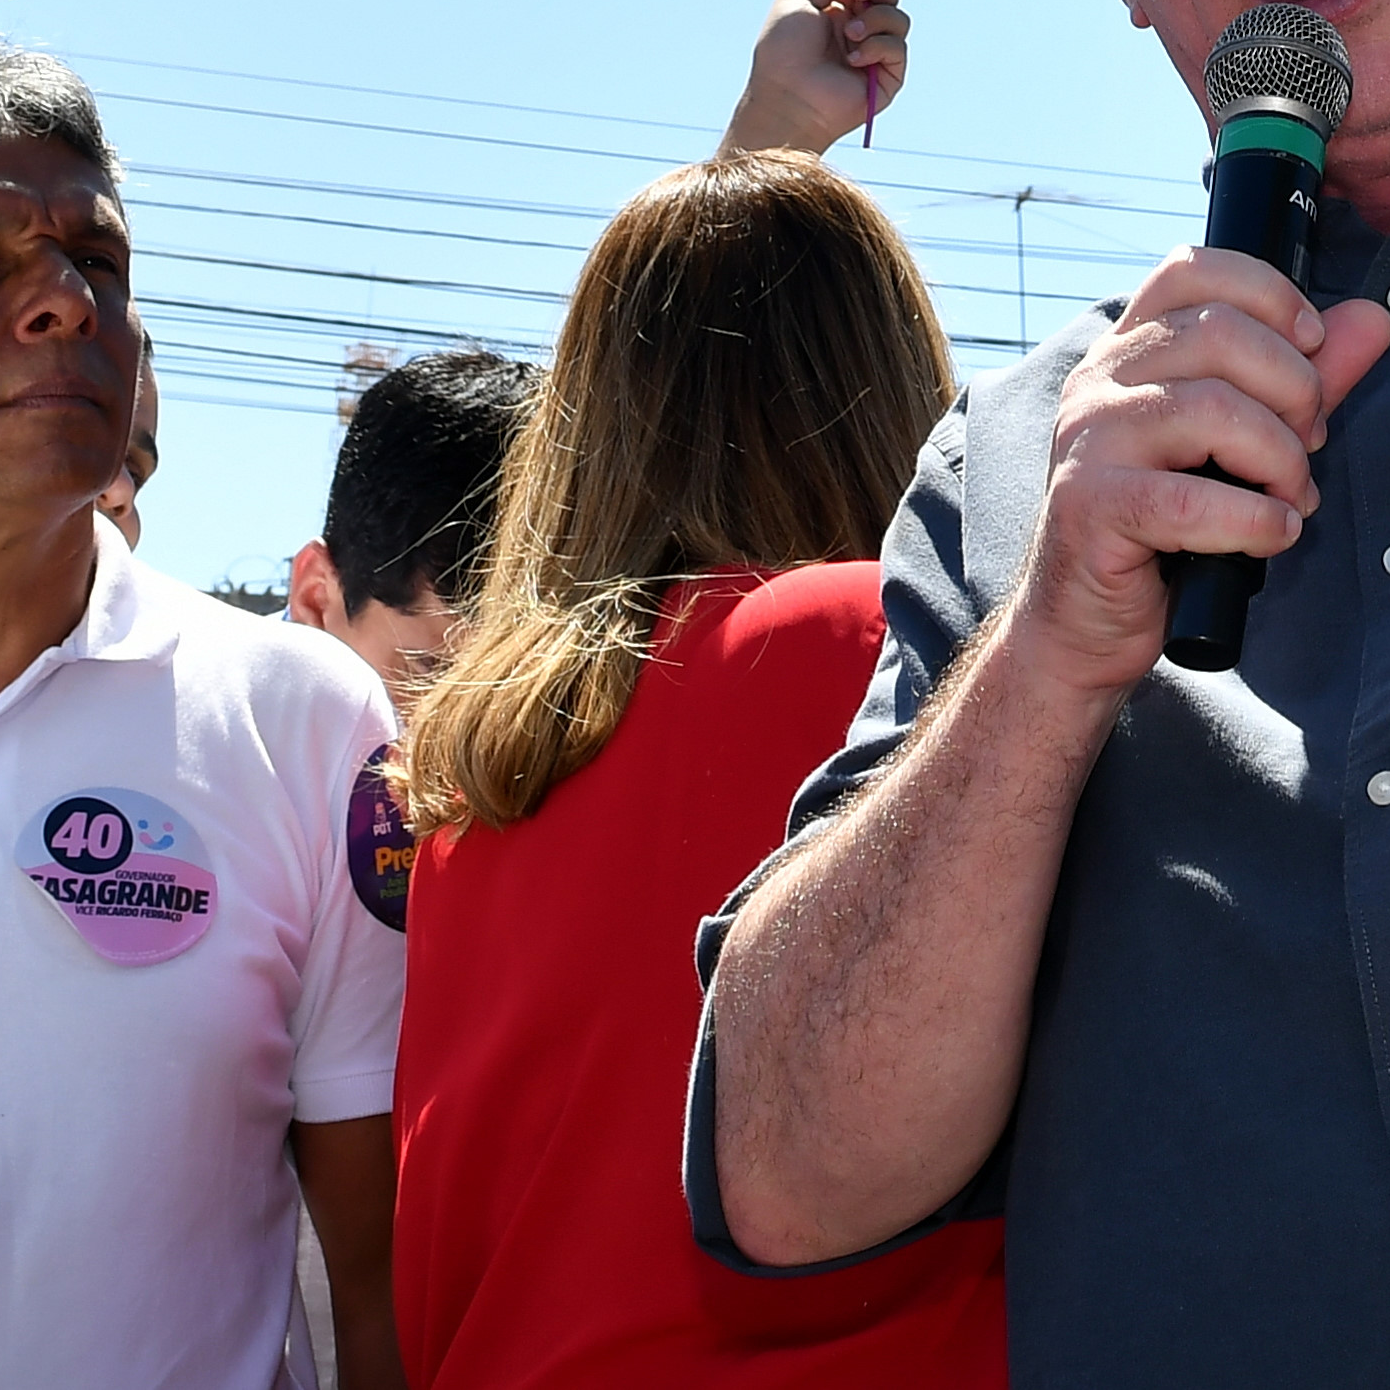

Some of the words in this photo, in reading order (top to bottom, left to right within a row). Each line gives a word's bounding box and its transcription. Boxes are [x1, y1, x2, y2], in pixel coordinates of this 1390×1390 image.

[50, 811, 124, 859] 40
[115, 869, 177, 883] GOVERNADOR
[76, 905, 93, 916] VICE
[95, 906, 139, 918] RICARDO
[140, 908, 183, 923] FERRAÇO
